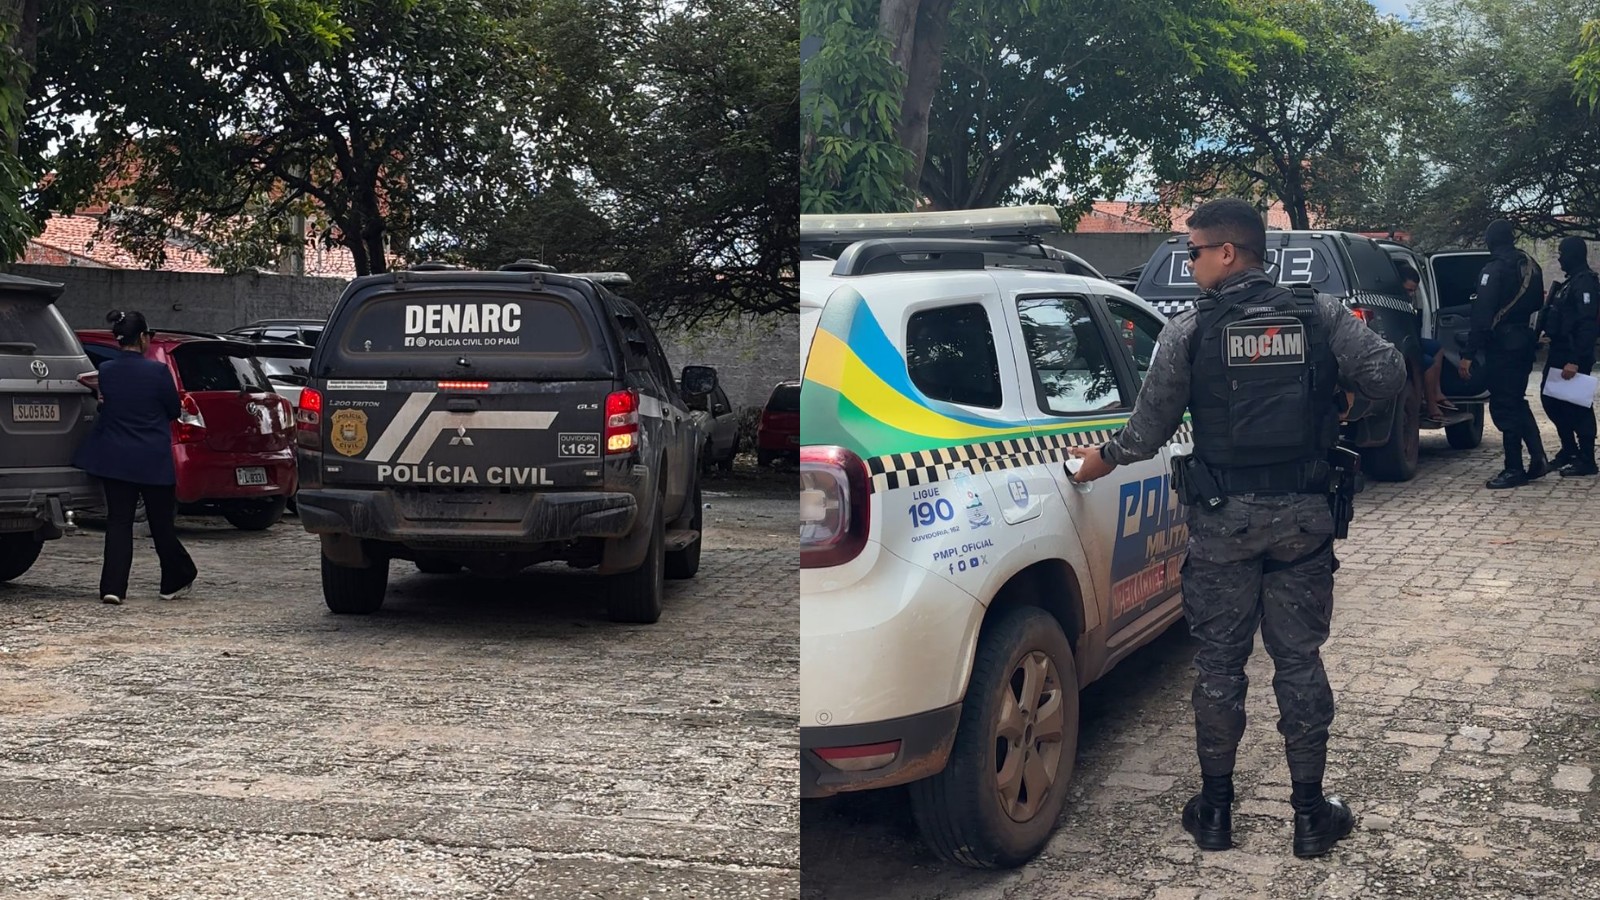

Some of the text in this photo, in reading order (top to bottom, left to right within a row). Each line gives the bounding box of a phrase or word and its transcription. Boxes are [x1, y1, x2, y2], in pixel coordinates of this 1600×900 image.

[404, 302, 522, 335] DENARC
[428, 336, 520, 347] POLÍCIA CIVIL DO PIAUÍ
[1230, 333, 1302, 358] ROCAM
[568, 443, 596, 454] 162
[377, 462, 554, 485] POLÍCIA CIVIL
[913, 487, 941, 501] LIGUE
[908, 498, 955, 528] 190
[932, 538, 995, 562] PMPI_OFICIAL
[1145, 522, 1189, 559] MILITA
